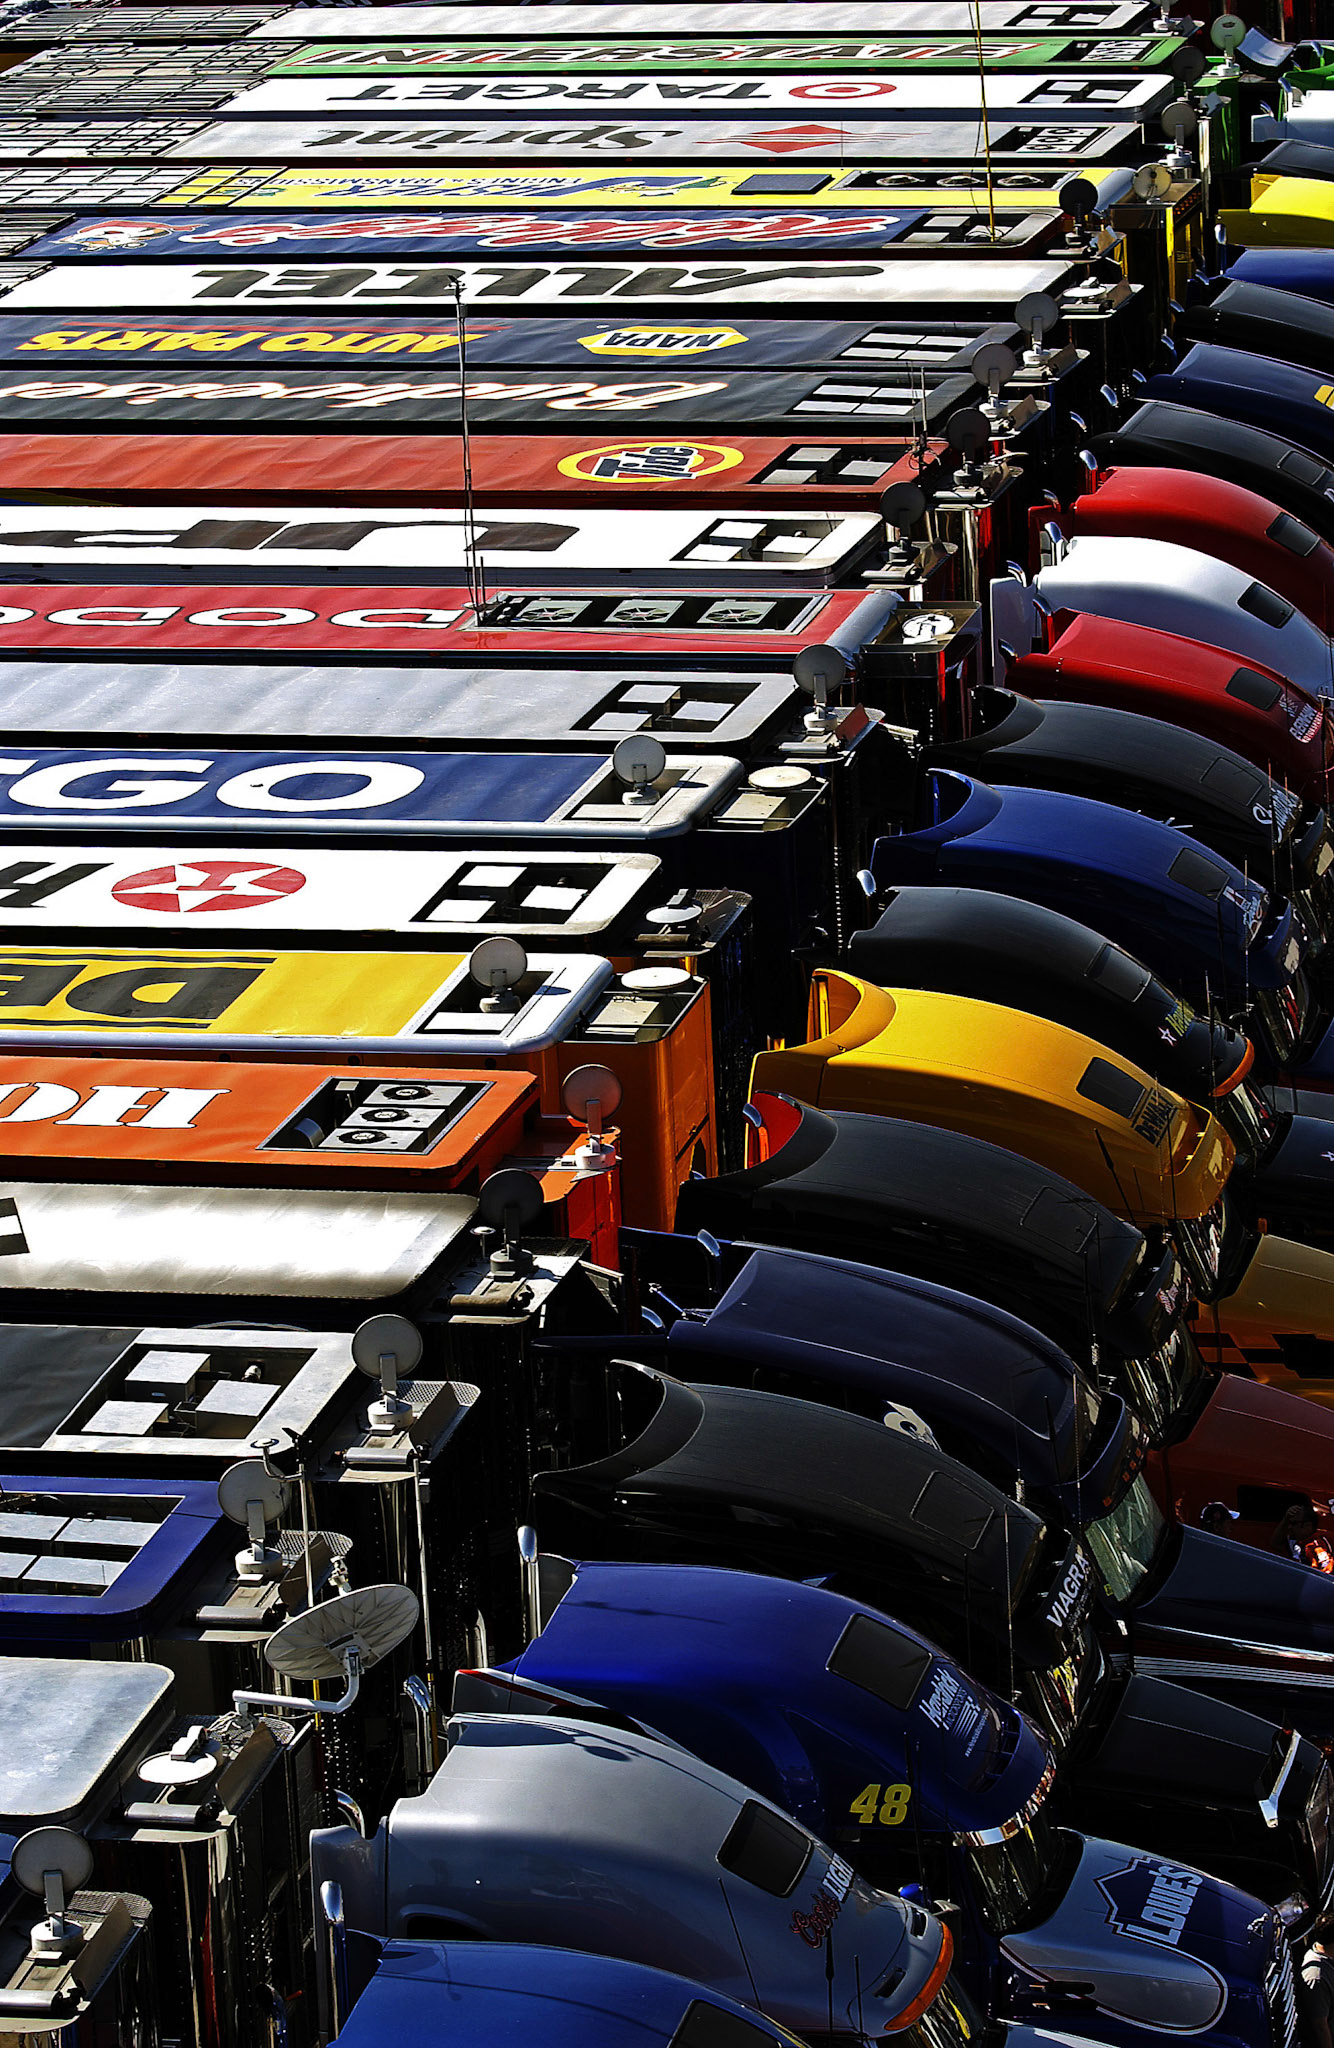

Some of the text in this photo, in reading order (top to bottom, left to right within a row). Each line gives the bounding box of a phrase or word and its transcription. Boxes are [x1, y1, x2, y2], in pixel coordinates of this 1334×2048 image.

[290, 43, 1041, 66] INTERSTATE
[328, 83, 772, 101] TARGET
[303, 126, 682, 150] Sprint
[315, 176, 704, 197] JASPER
[466, 176, 582, 185] ENGINES
[180, 215, 898, 248] Kellogg's
[192, 266, 885, 298] ALLTEL
[16, 330, 486, 353] AUTO PARTS
[604, 332, 724, 350] NAPA
[0, 381, 729, 411] Budweise
[590, 444, 698, 480] Tide
[0, 520, 580, 551] UP
[0, 605, 465, 629] DOD
[1046, 1553, 1089, 1628] VIAGRA
[850, 1784, 913, 1825] 48
[790, 1888, 841, 1949] Coors
[1125, 1865, 1204, 1945] LOWE'S
